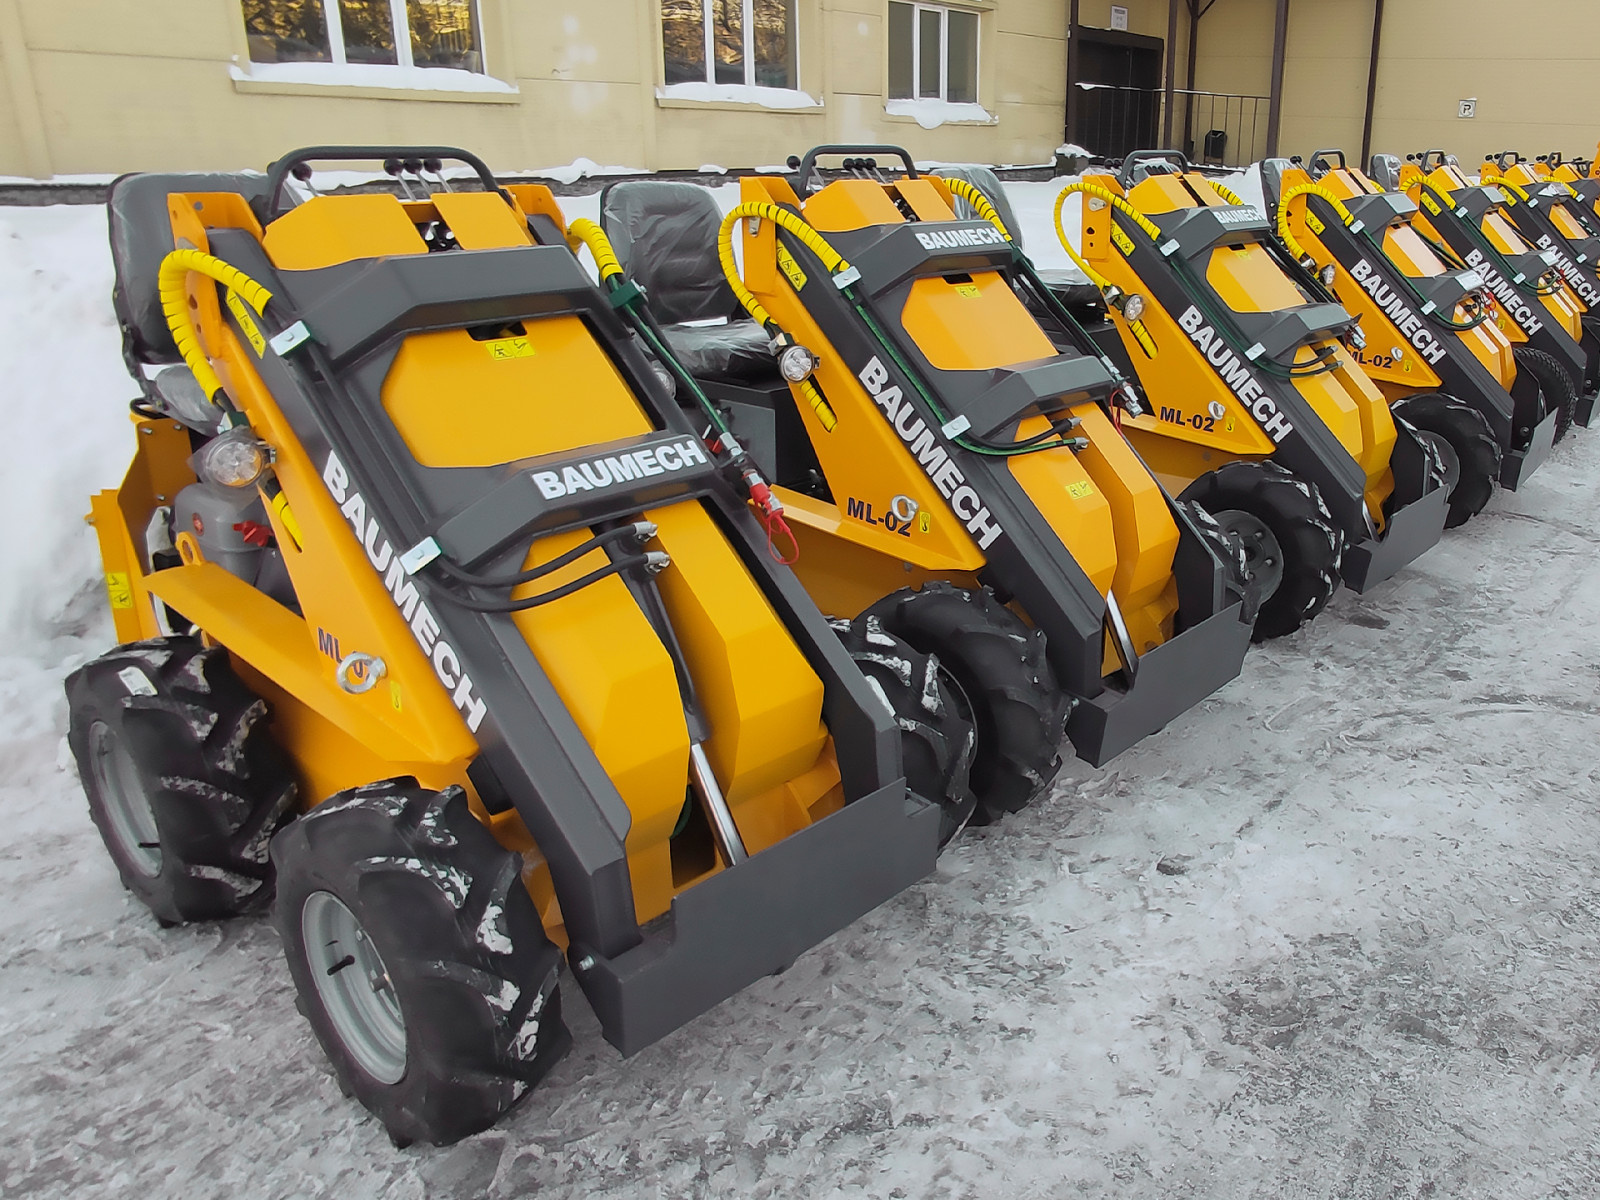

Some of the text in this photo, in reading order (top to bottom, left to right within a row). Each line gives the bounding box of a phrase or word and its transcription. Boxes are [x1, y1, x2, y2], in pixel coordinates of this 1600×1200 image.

[914, 226, 1004, 251] BAUMECH
[1349, 258, 1447, 365] BAUMECH
[1464, 248, 1543, 336] BAUMECH
[1177, 304, 1293, 443] BAUMECH
[858, 355, 1003, 551] BAUMECH
[1159, 406, 1215, 433] ML-02
[532, 440, 707, 500] BAUMECH
[847, 497, 912, 538] ML-02
[322, 449, 489, 734] BAUMECH
